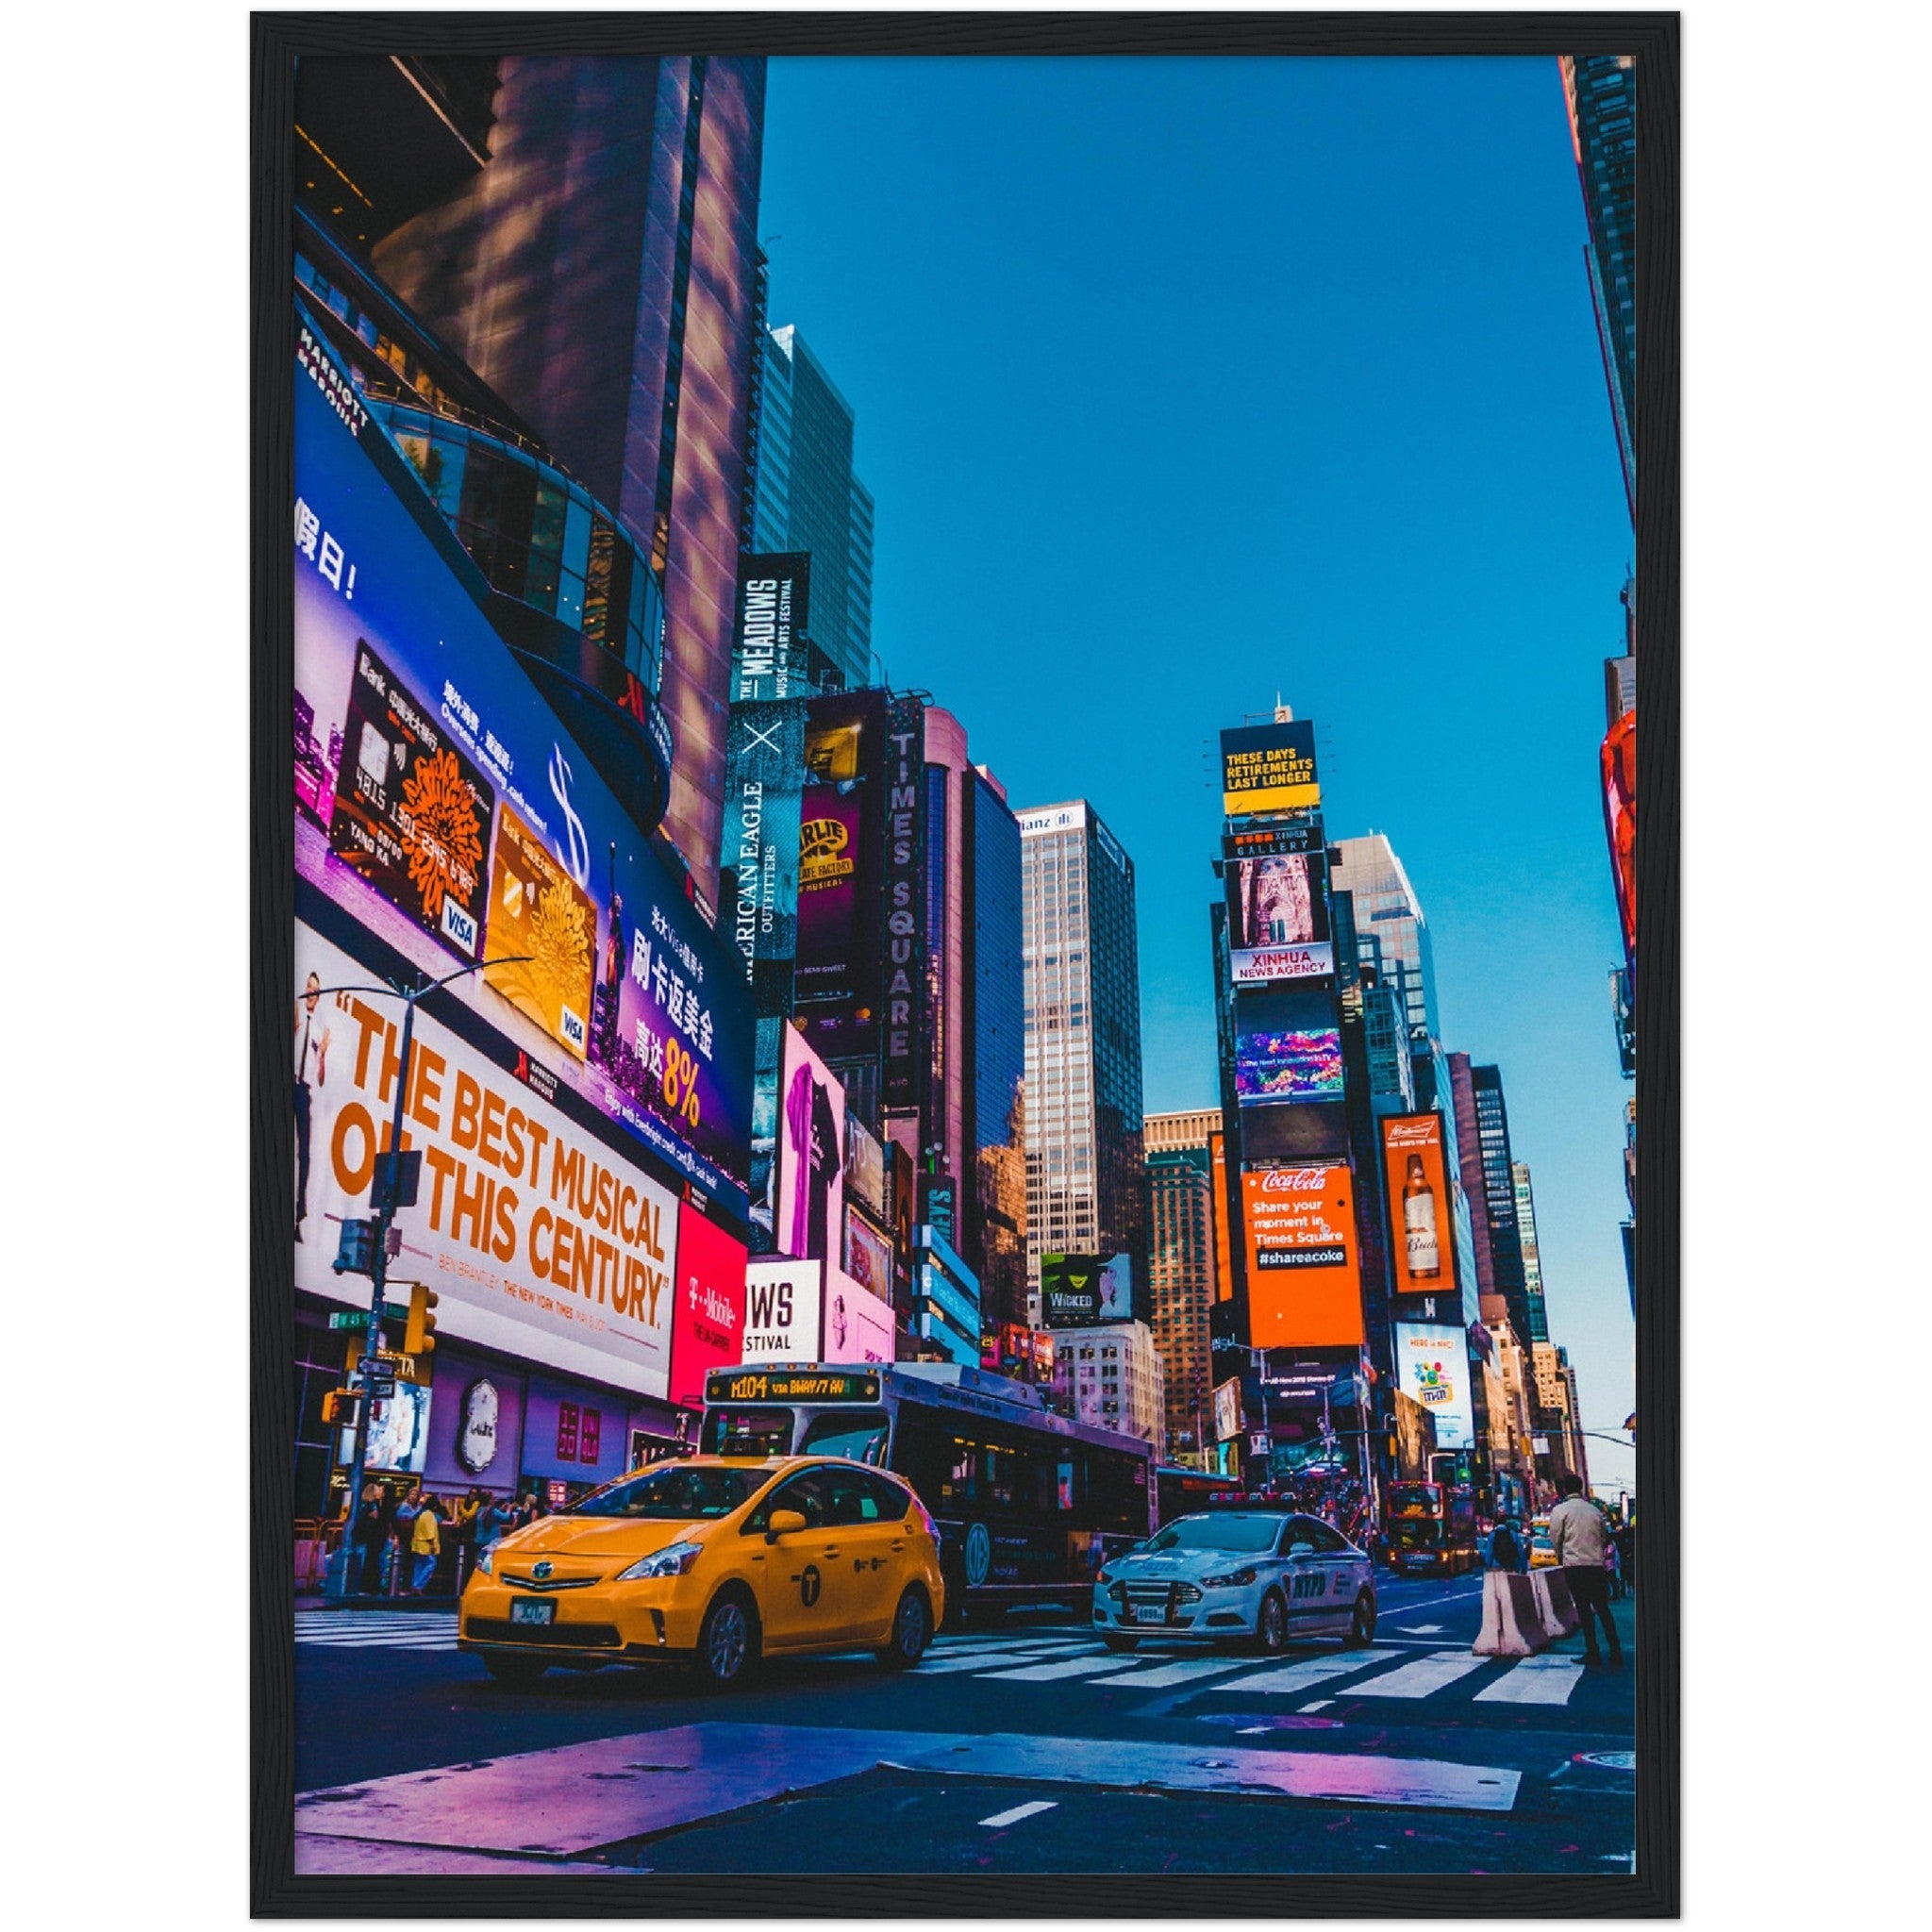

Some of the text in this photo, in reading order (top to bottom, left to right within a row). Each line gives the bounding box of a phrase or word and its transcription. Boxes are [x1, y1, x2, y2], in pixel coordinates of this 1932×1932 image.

[779, 578, 793, 622] FESTIVAL
[740, 578, 778, 700] THE MEADOWS
[777, 625, 791, 650] ARTS
[775, 667, 789, 699] MUSIC
[1226, 748, 1297, 766] THESE DAYS
[1226, 758, 1314, 778] RETIREMENTS
[1227, 771, 1311, 791] LAST LONGER
[891, 732, 916, 865] TIMES
[740, 781, 763, 859] EAGLE
[1022, 818, 1051, 831] ianz
[800, 821, 843, 851] RLIE
[1237, 840, 1308, 856] GALLERY
[760, 845, 777, 934] OUTFITTERS
[447, 904, 473, 946] VISA
[889, 881, 916, 1058] SQUARE
[1239, 961, 1326, 979] NEWS AGENCY
[1252, 950, 1312, 968] XINHUA
[564, 1012, 583, 1045] VISA
[450, 1068, 549, 1190] BEST
[550, 1136, 665, 1263] MUSICAL
[1261, 1168, 1329, 1193] Coca-Cola
[425, 1143, 520, 1263] THIS
[1252, 1200, 1324, 1214] Share your
[1254, 1215, 1324, 1229] moment in
[1255, 1230, 1344, 1245] Times Square
[1259, 1249, 1344, 1265] #shareacoke
[503, 1278, 518, 1298] THE
[518, 1286, 536, 1305] NEW
[536, 1293, 554, 1312] YORK
[556, 1300, 574, 1320] TIMES
[743, 1282, 793, 1329] WS
[741, 1334, 791, 1352] STIVAL
[731, 1375, 768, 1399] M104
[1293, 1572, 1326, 1599] NYPD
